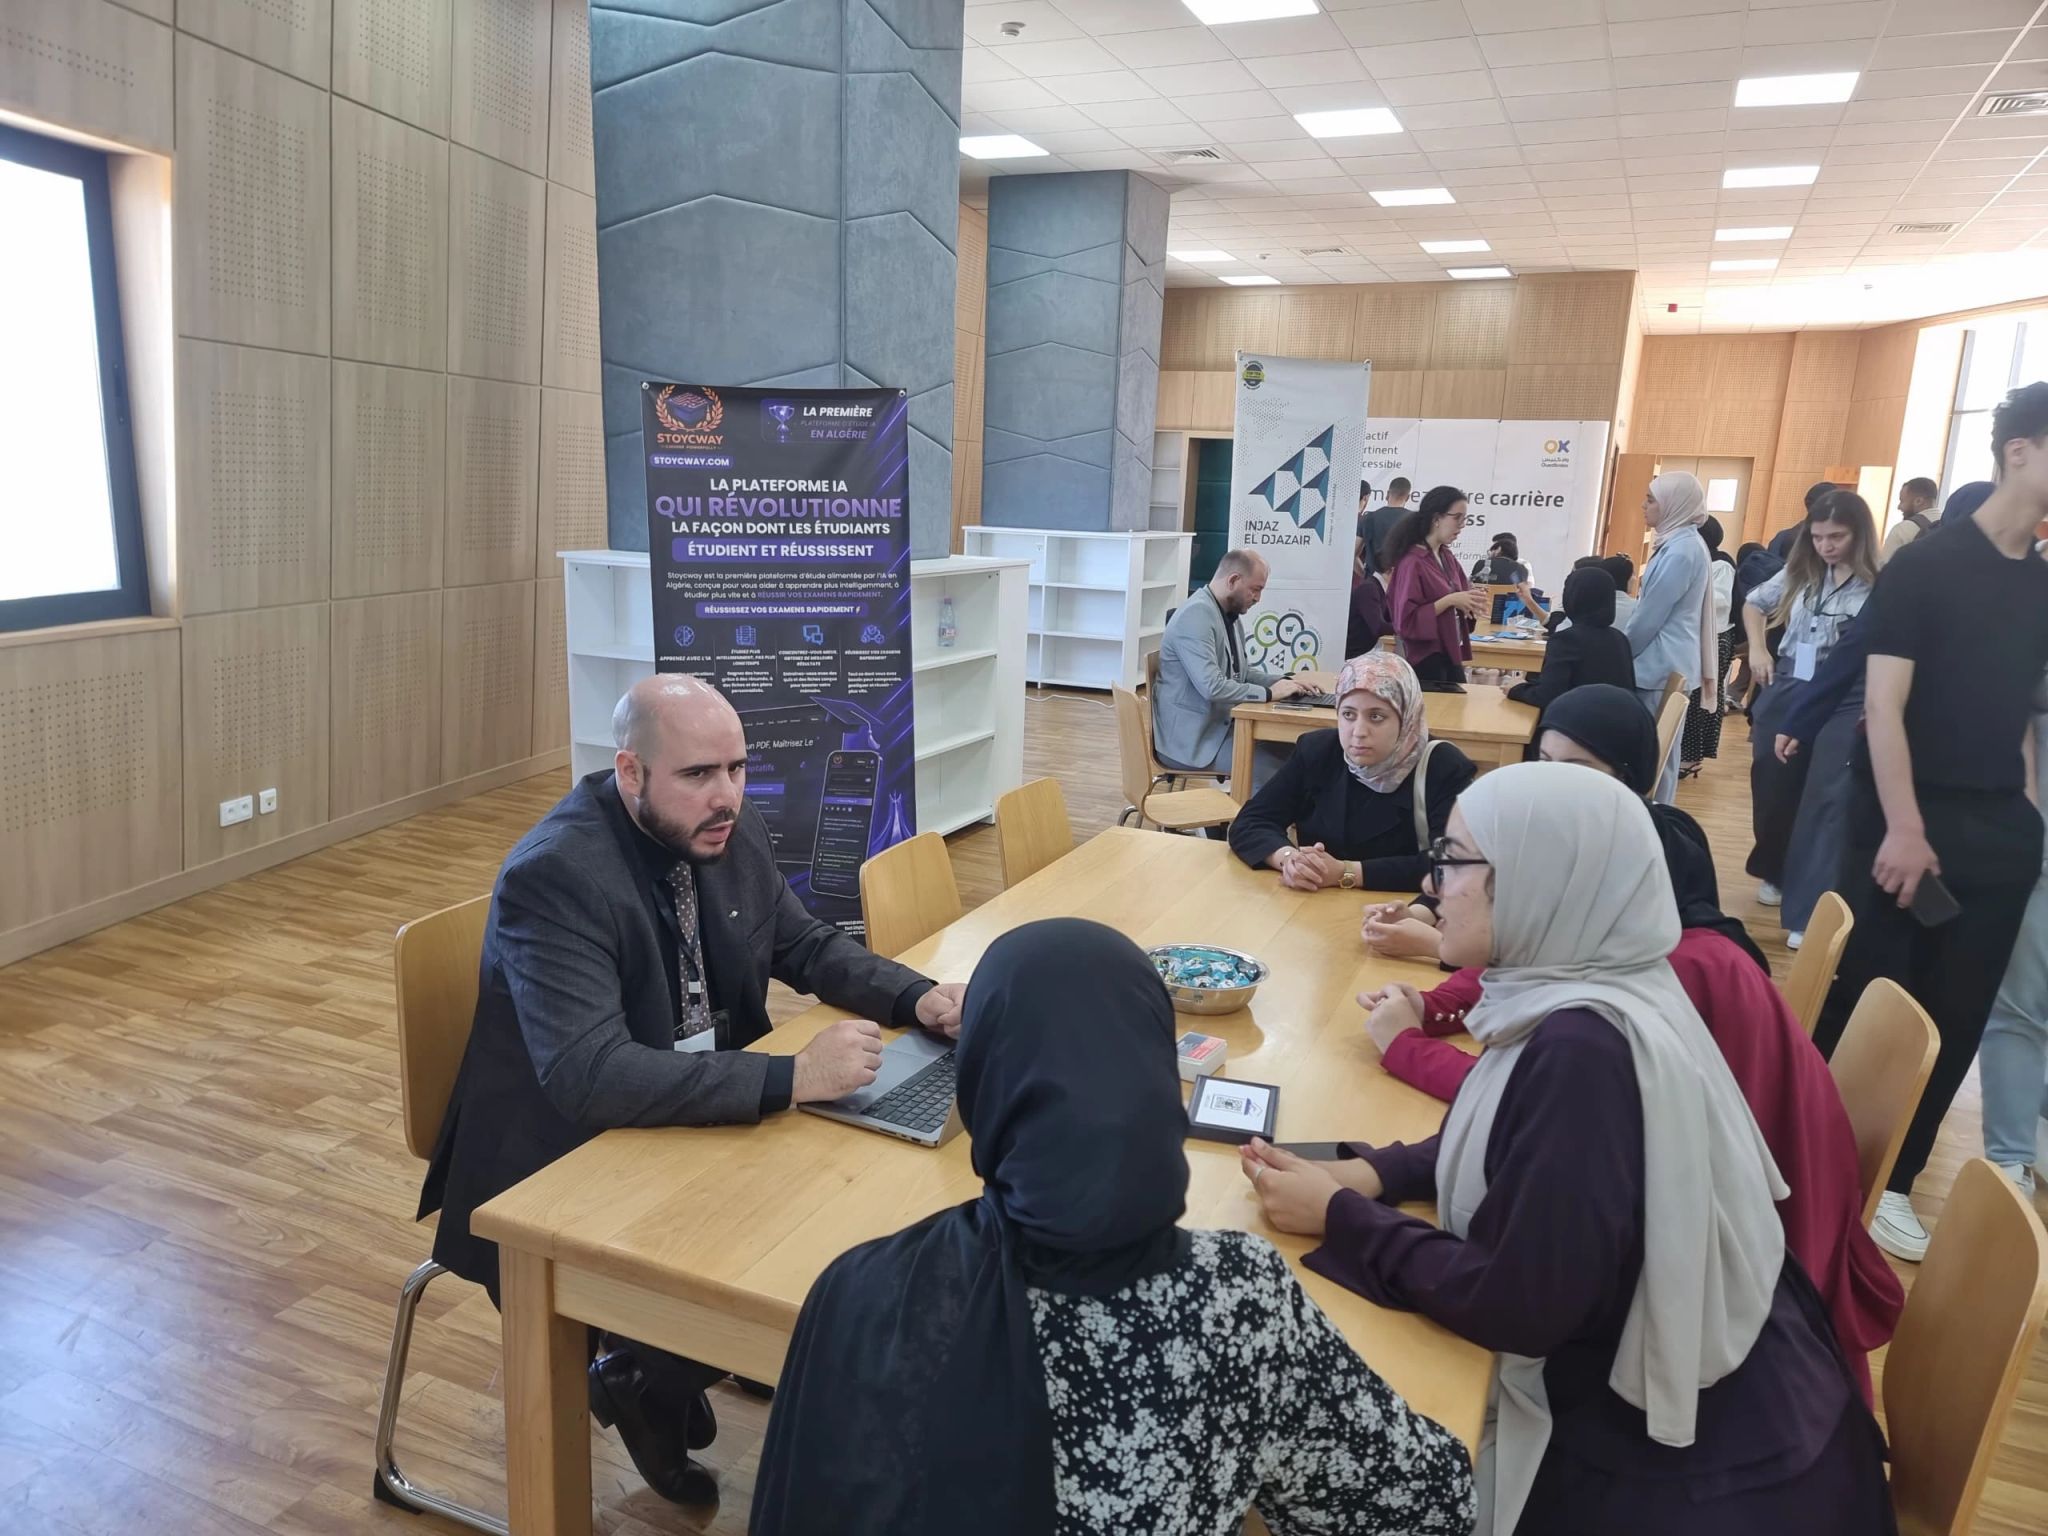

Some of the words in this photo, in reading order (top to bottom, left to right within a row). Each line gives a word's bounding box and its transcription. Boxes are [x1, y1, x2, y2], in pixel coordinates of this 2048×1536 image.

[803, 407, 816, 416] LA
[819, 405, 873, 417] PREMIÈRE
[657, 433, 723, 445] STOYCWAY
[811, 430, 824, 438] EN
[826, 428, 867, 439] ALGÉRIE
[1366, 431, 1389, 441] actif
[1363, 446, 1399, 455] rtinent
[1544, 439, 1570, 454] OK
[654, 457, 729, 466] STOYCWAY.COM
[1362, 460, 1402, 469] cessible
[710, 479, 729, 491] LA
[732, 479, 829, 492] PLATEFORME
[833, 480, 848, 492] IA
[655, 496, 701, 518] QUI
[708, 491, 902, 518] RÉVOLUTIONNE
[1490, 490, 1565, 508] carrière
[672, 522, 689, 533] LA
[692, 522, 743, 537] FAÇON
[746, 523, 786, 534] DONT
[789, 523, 812, 534] LES
[815, 520, 891, 534] ÉTUDIANTS
[1245, 521, 1279, 531] INJAZ
[1245, 534, 1258, 544] EL
[1261, 534, 1311, 545] DJAZAIR
[688, 541, 758, 557] ÉTUDIENT
[761, 545, 777, 557] ET
[780, 542, 874, 557] RÉUSSISSENT
[725, 572, 757, 580] première
[759, 572, 797, 580] plateforme
[666, 582, 692, 590] Algérie,
[785, 582, 822, 590] apprendre
[824, 582, 838, 590] plus
[684, 591, 709, 599] étudier
[711, 592, 726, 600] plus
[705, 605, 749, 613] RÉUSSISSEZ
